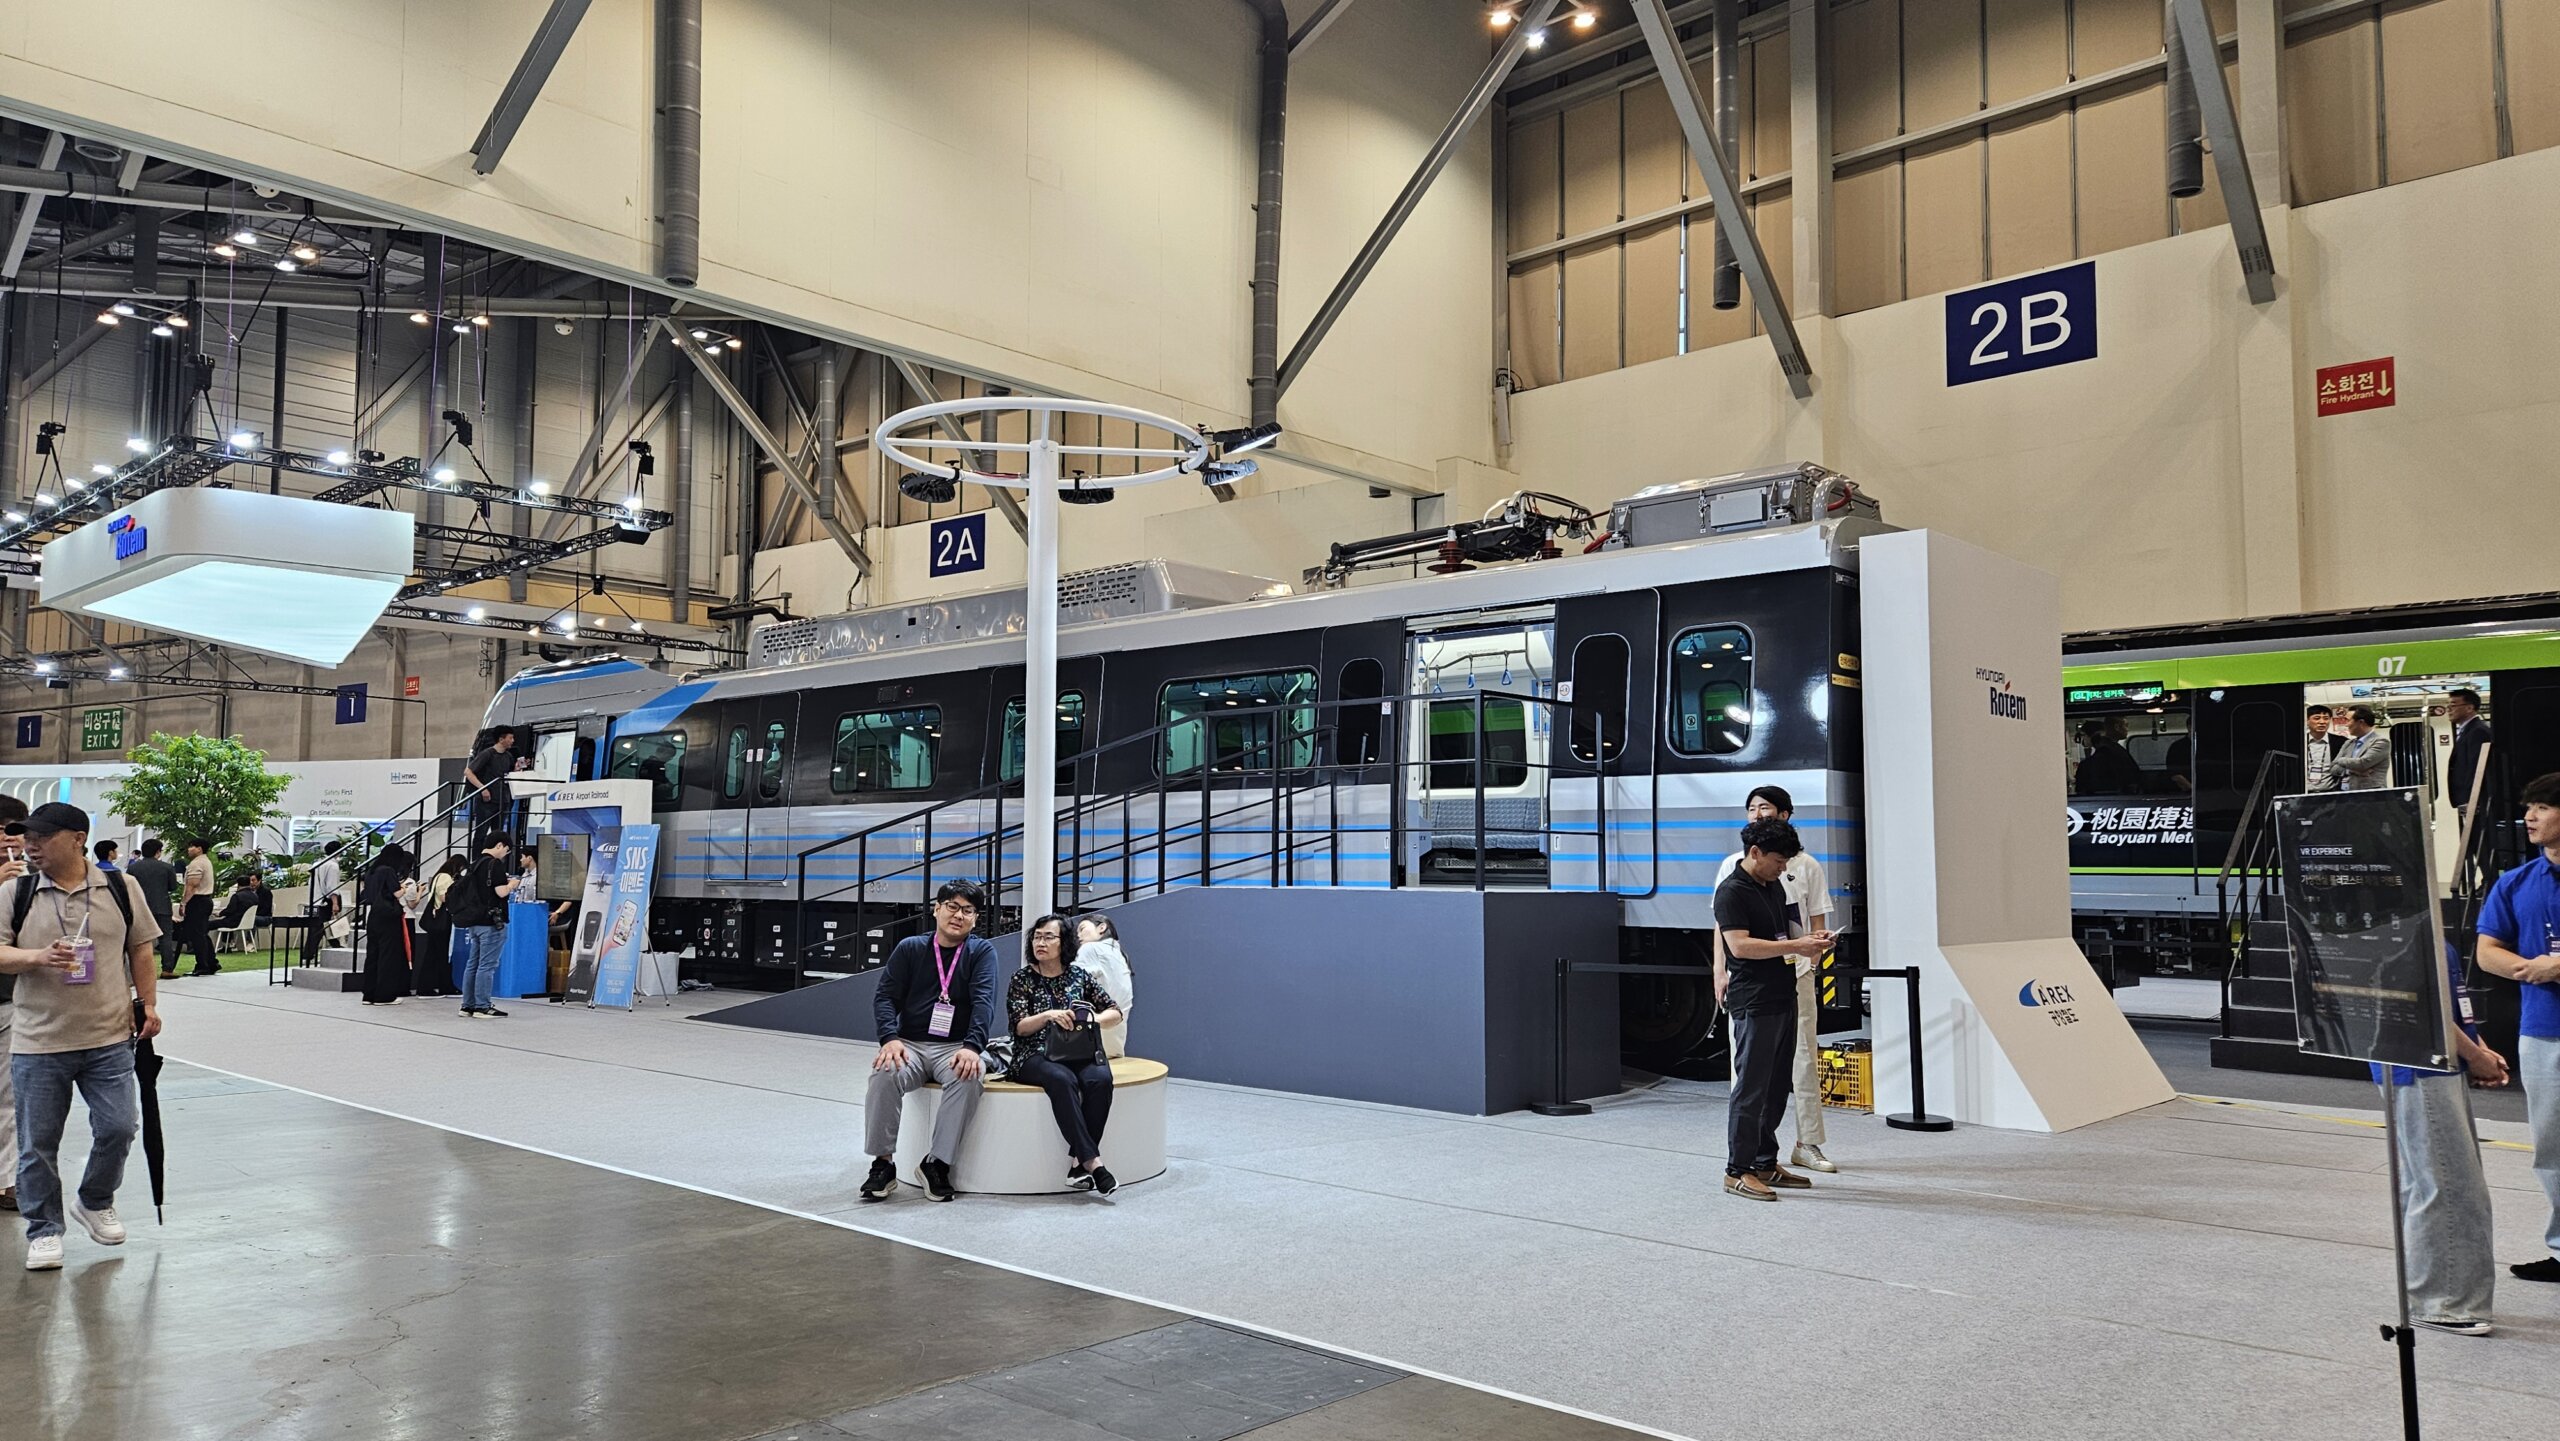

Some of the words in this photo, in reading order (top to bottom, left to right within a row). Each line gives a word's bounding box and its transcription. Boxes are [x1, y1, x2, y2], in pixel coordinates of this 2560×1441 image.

[1970, 291, 2072, 366] 2B
[2320, 371, 2375, 396] 소화전
[2320, 397, 2338, 405] Fire
[2339, 391, 2375, 402] Hydrant
[116, 526, 147, 560] Rotem
[937, 527, 977, 567] 2A
[1975, 667, 2006, 684] HYUNDAI
[2378, 656, 2407, 676] 07
[1990, 686, 2027, 721] Rotem
[27, 721, 32, 743] 1
[84, 712, 111, 731] 비상구
[86, 734, 108, 748] EXIT
[320, 799, 333, 807] High
[2090, 832, 2157, 847] Taoyuan
[623, 846, 649, 870] SNS
[2300, 847, 2310, 855] VR
[2311, 847, 2353, 855] EXPERIENCE
[619, 871, 645, 893] 이벤트
[2037, 985, 2076, 1006] AREX
